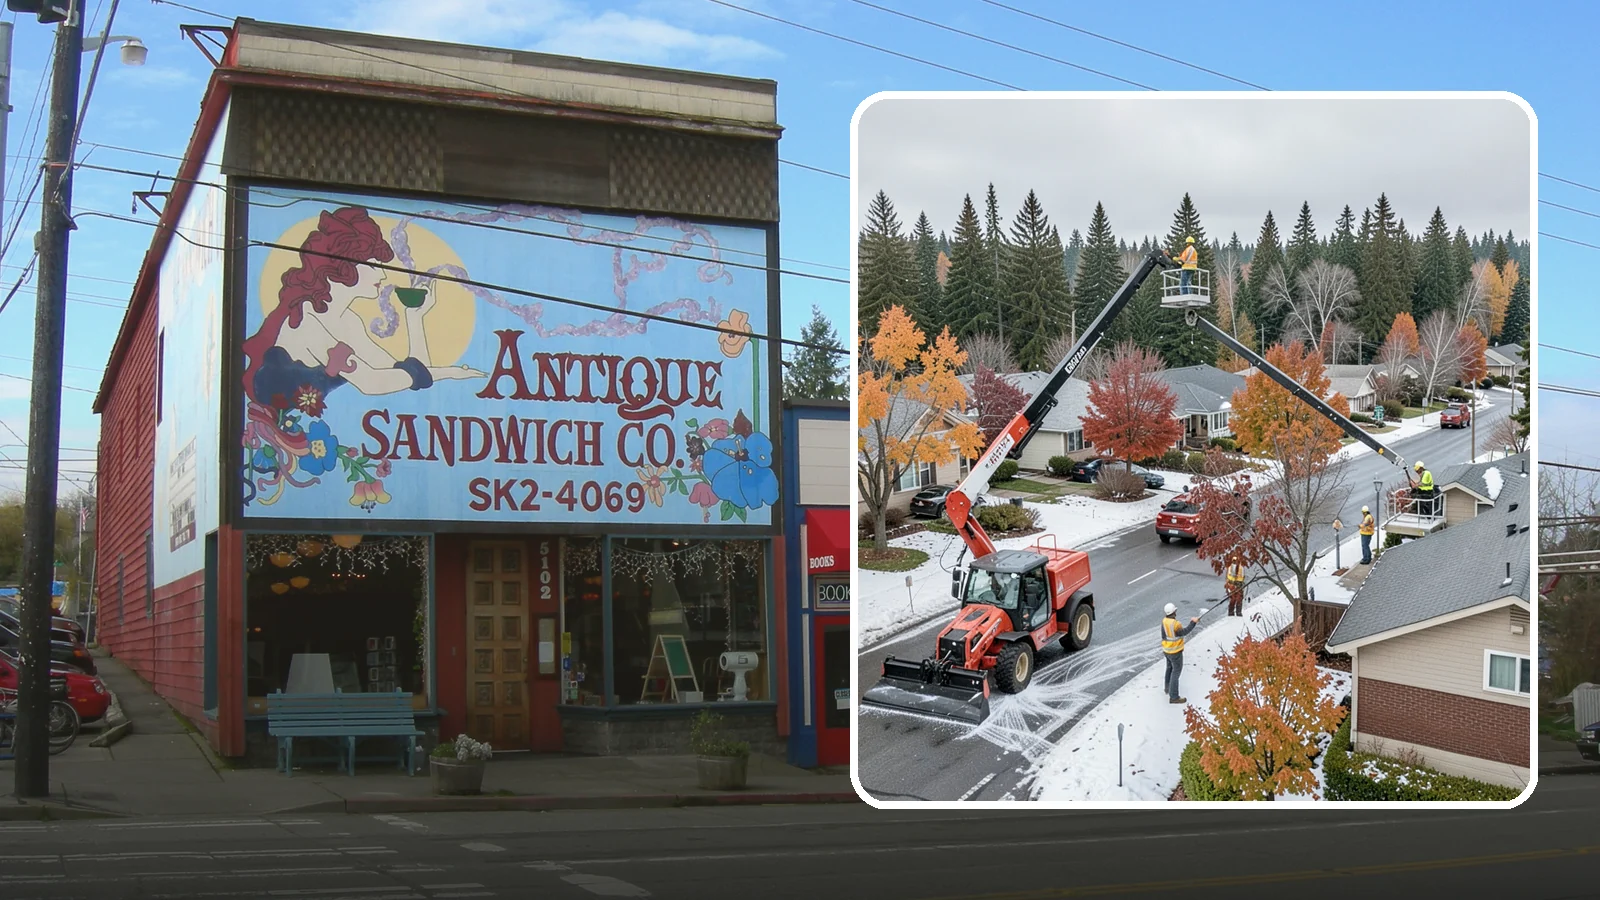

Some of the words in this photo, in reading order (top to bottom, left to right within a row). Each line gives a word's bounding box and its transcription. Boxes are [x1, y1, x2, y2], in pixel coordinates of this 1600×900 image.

[476, 328, 724, 421] ANTIQUE
[361, 408, 604, 467] SANDWICH
[617, 421, 685, 469] CO.
[468, 477, 646, 513] SK2-4069
[539, 541, 552, 600] 5102
[809, 555, 835, 569] BOOKS
